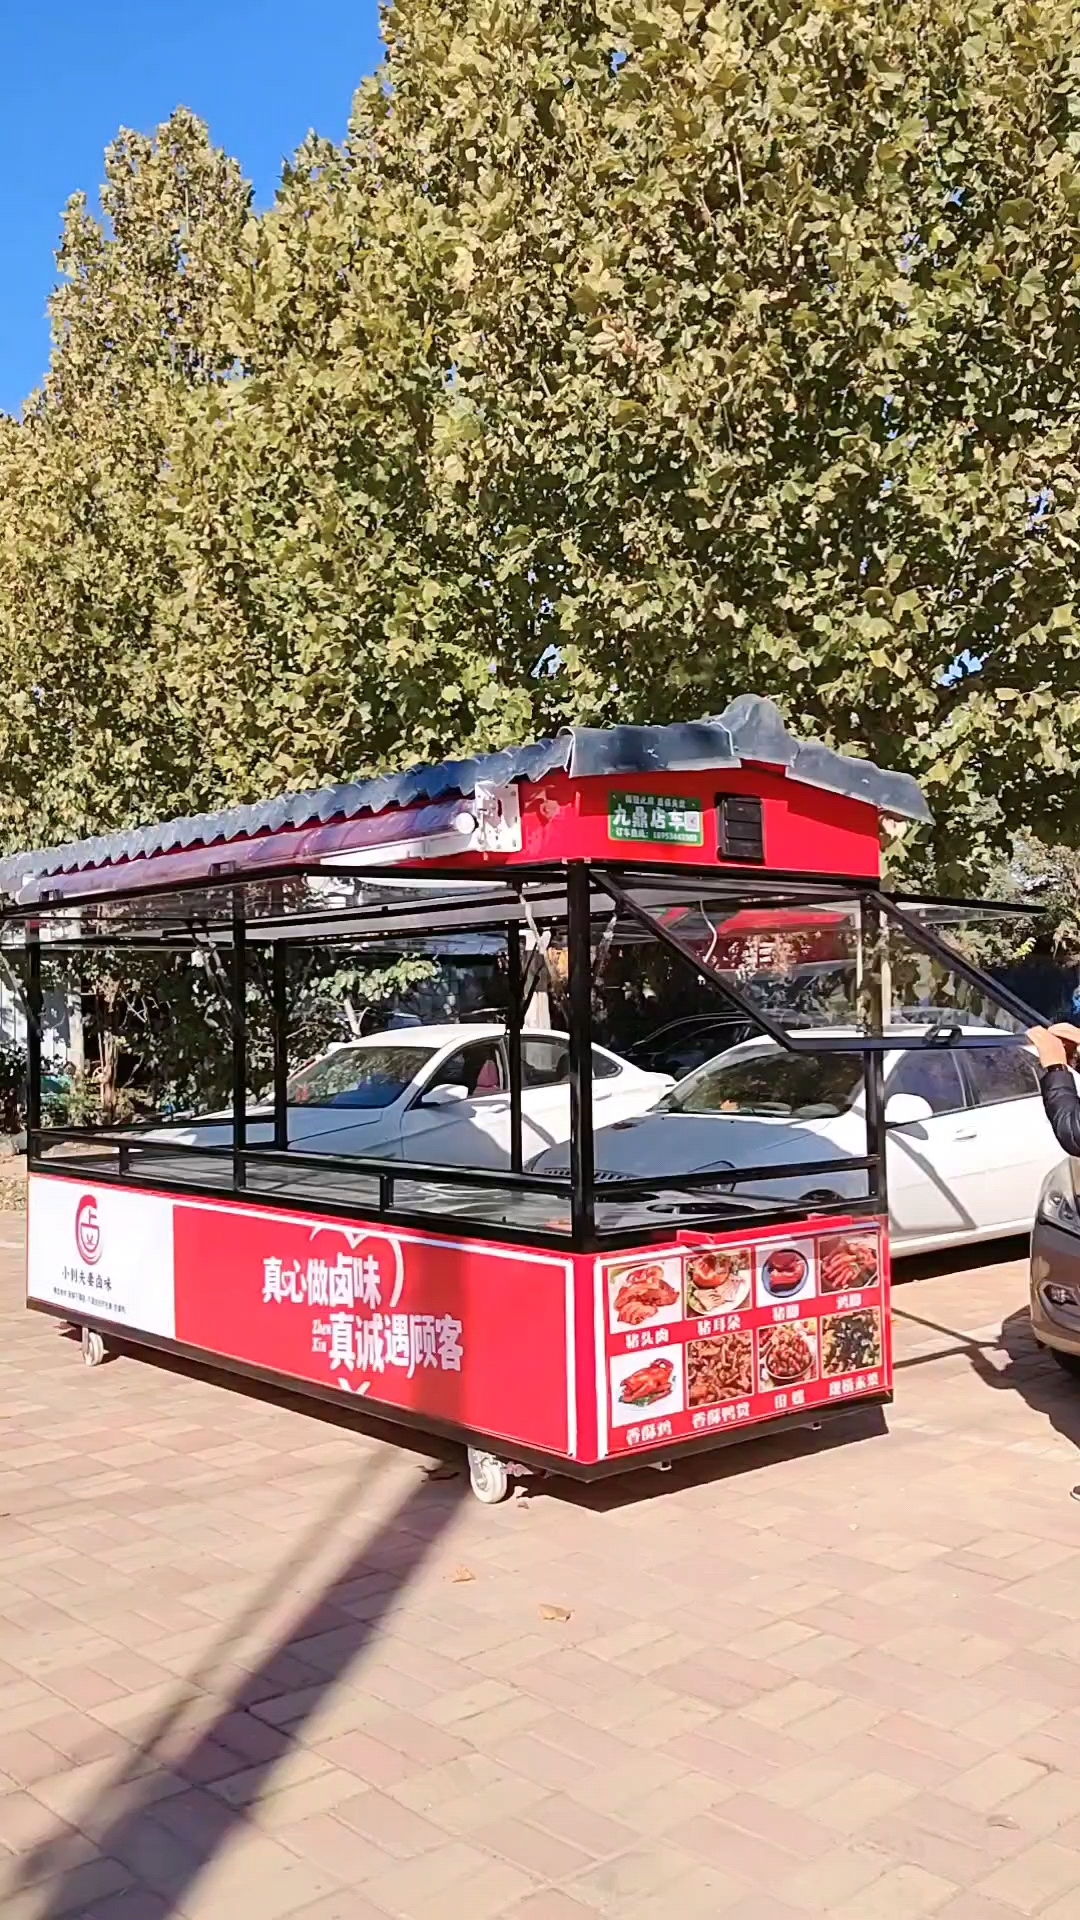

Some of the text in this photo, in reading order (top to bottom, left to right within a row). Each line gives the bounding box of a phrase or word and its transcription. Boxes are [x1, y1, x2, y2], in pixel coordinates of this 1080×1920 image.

[613, 803, 685, 832] 九鼎店车
[262, 1252, 382, 1309] 真心做卤味
[625, 1327, 669, 1349] 猪头肉
[697, 1314, 741, 1336] 猪耳朵
[329, 1311, 464, 1379] 真诚遇顾客
